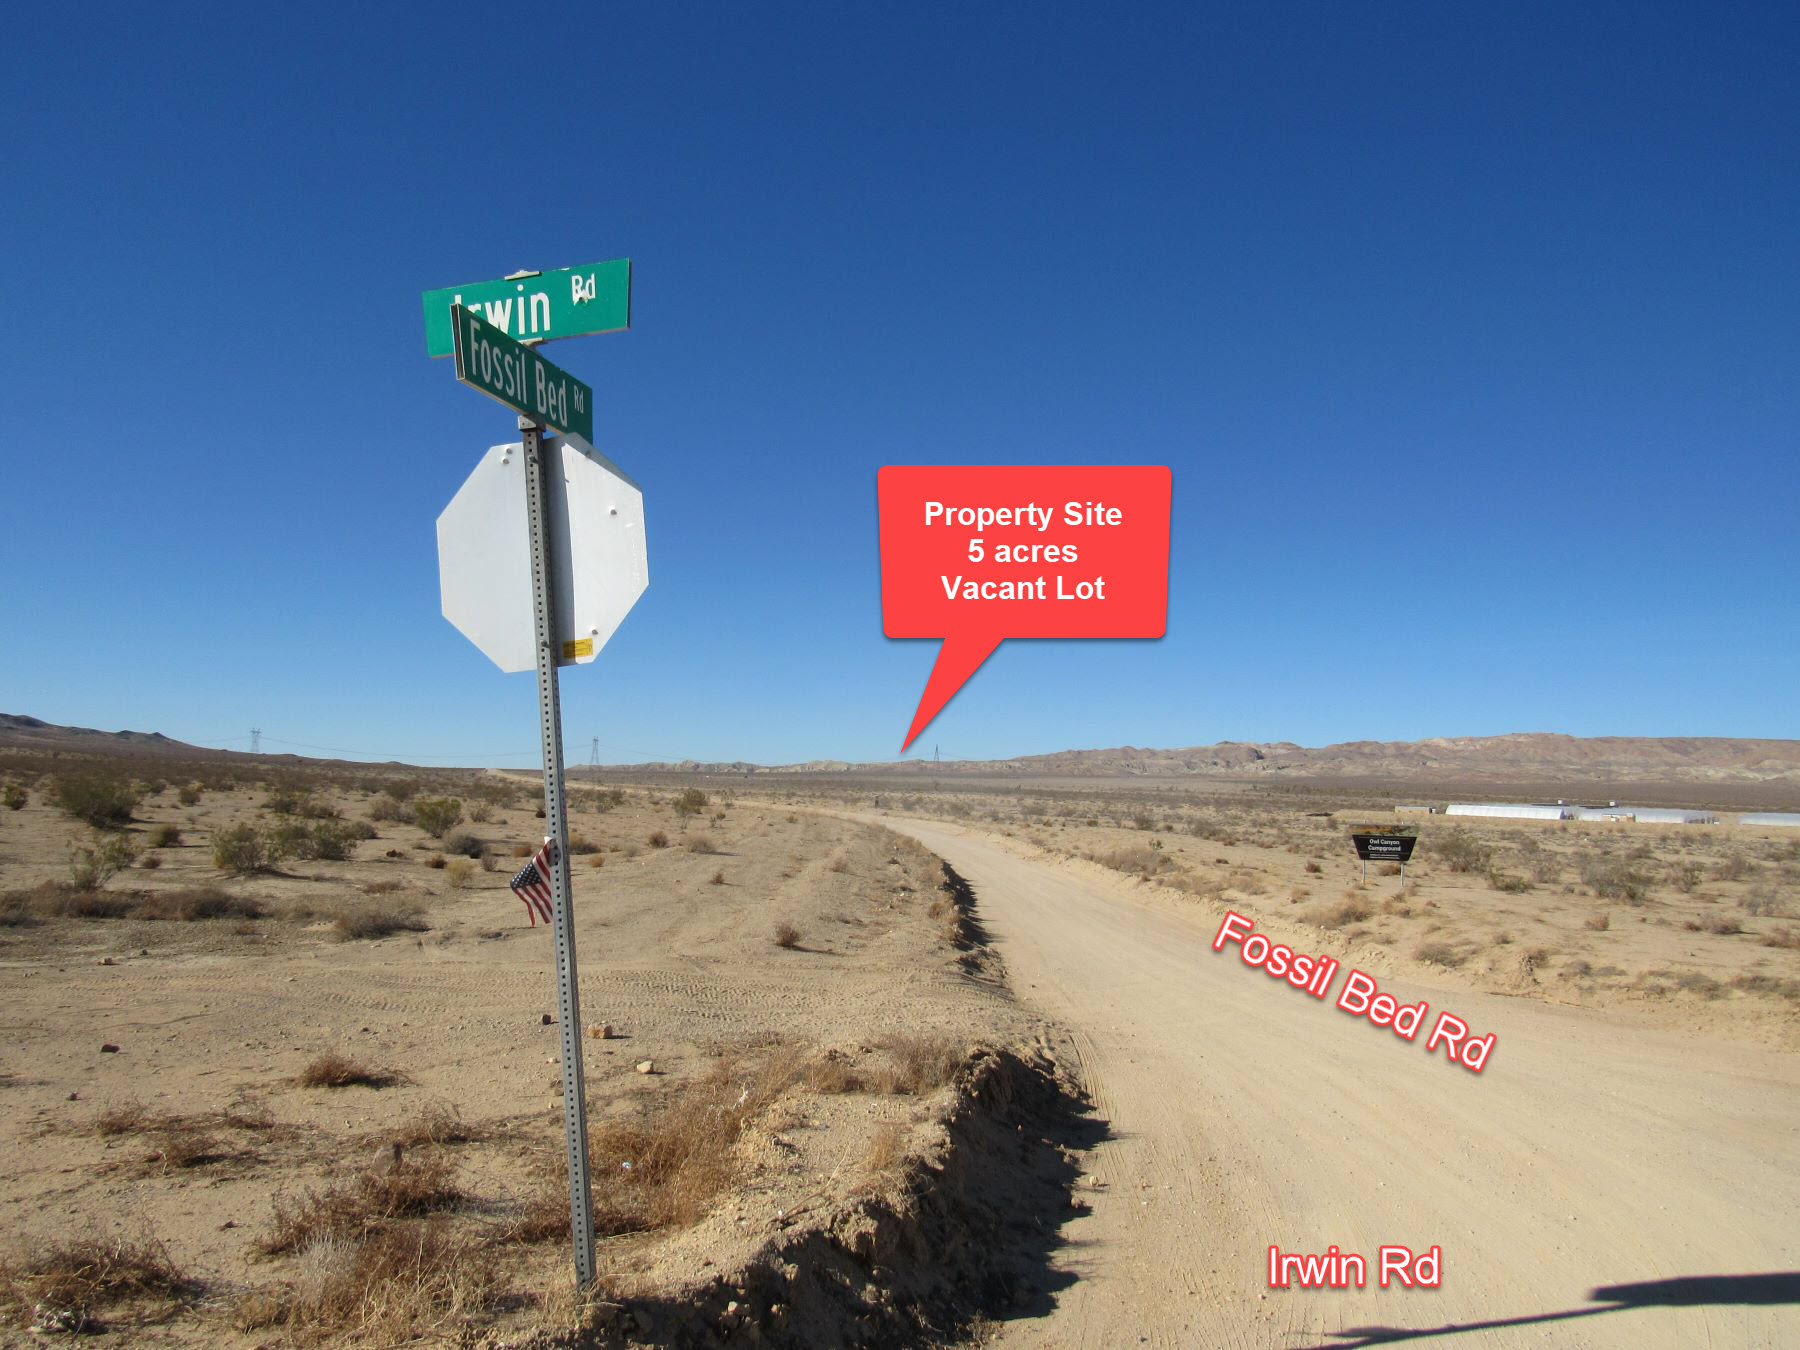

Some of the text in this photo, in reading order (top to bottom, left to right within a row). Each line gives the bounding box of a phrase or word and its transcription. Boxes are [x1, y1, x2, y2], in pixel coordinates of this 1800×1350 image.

[455, 273, 596, 335] win Rd
[470, 318, 584, 427] Fossil Bed Rd
